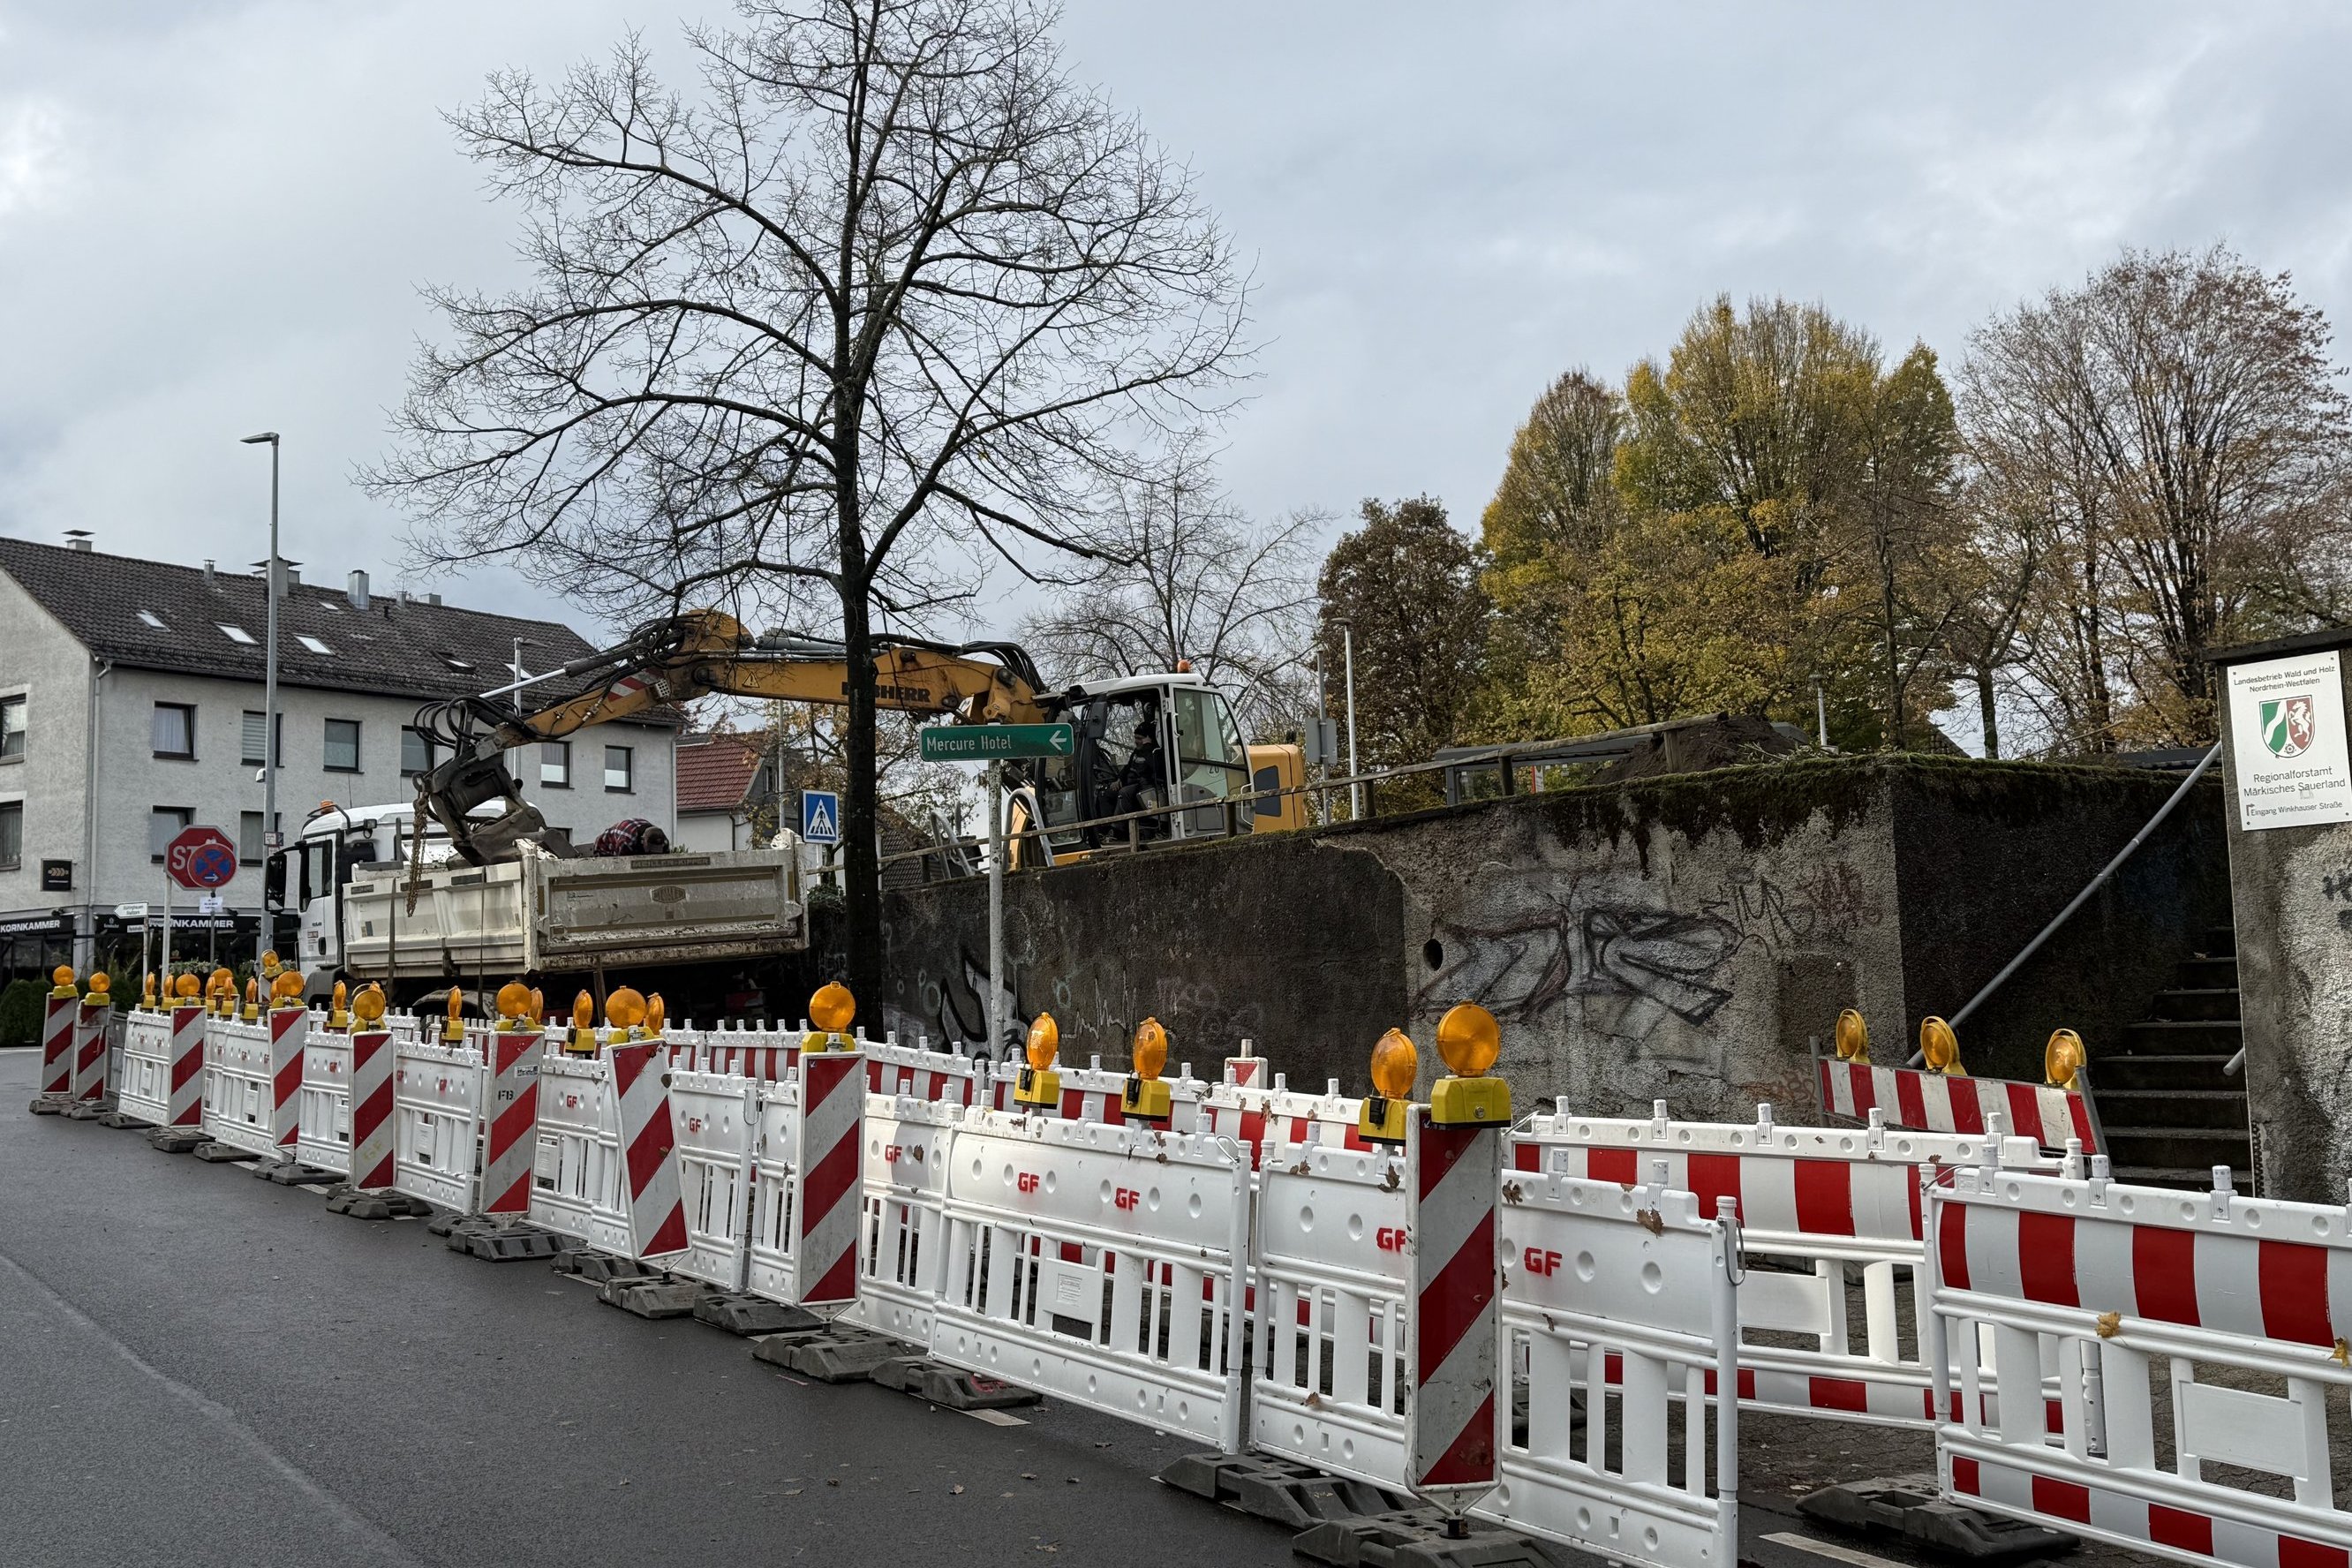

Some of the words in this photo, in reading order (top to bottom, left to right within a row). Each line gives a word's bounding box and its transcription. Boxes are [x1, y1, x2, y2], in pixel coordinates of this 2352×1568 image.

[2234, 672, 2283, 686] Landesbetrieb
[2249, 677, 2320, 693] Nordrhein-Westfalen
[926, 736, 976, 751] Mercure
[980, 735, 1012, 750] Hotel
[2253, 766, 2333, 784] Regionalforstamt
[2243, 784, 2295, 797] Märkisches
[2297, 779, 2346, 792] Sauerland
[2250, 807, 2277, 817] Eingang
[2318, 801, 2343, 810] Straße
[0, 919, 61, 933] KORNKAMMER
[567, 1094, 577, 1109] GF
[689, 1117, 702, 1133] GF
[884, 1144, 902, 1163] GF
[1017, 1172, 1040, 1194] GF
[1114, 1187, 1140, 1211] GF
[1524, 1247, 1563, 1277] GF
